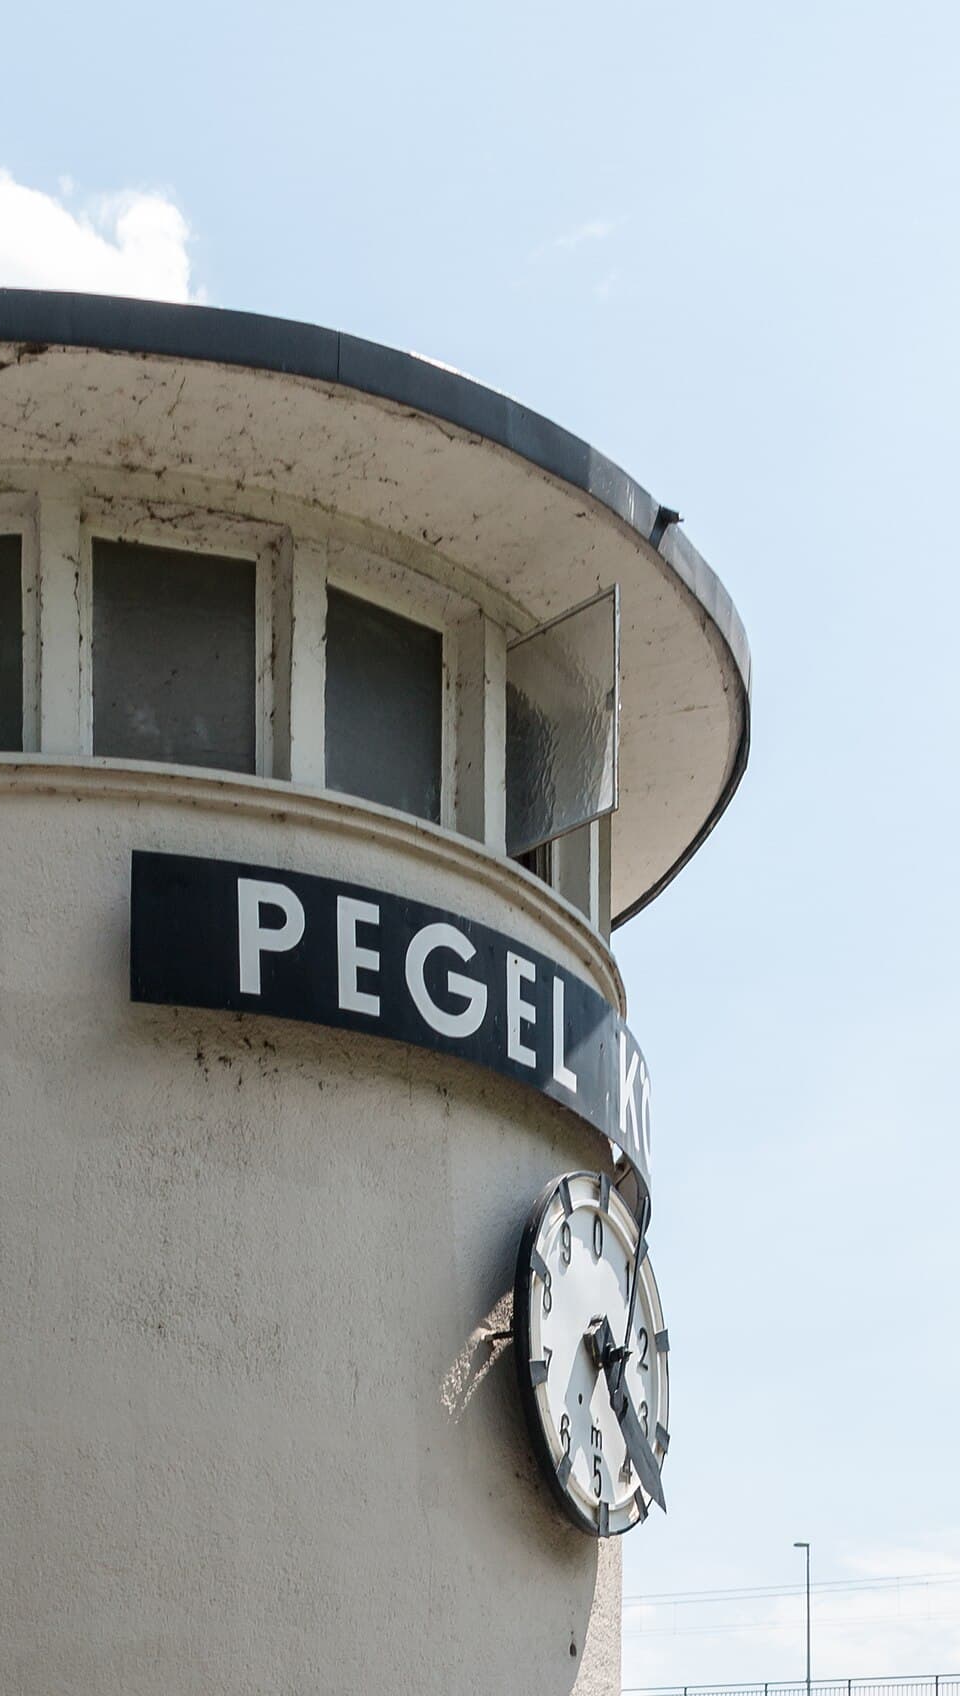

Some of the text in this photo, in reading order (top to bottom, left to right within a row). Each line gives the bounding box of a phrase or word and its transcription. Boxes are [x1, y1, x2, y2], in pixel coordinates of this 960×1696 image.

[237, 877, 579, 1093] PEGEL
[560, 1222, 572, 1266] 9
[592, 1215, 604, 1259] 0
[543, 1271, 553, 1313] 8
[638, 1327, 649, 1370] 2
[592, 1454, 604, 1498] 5
